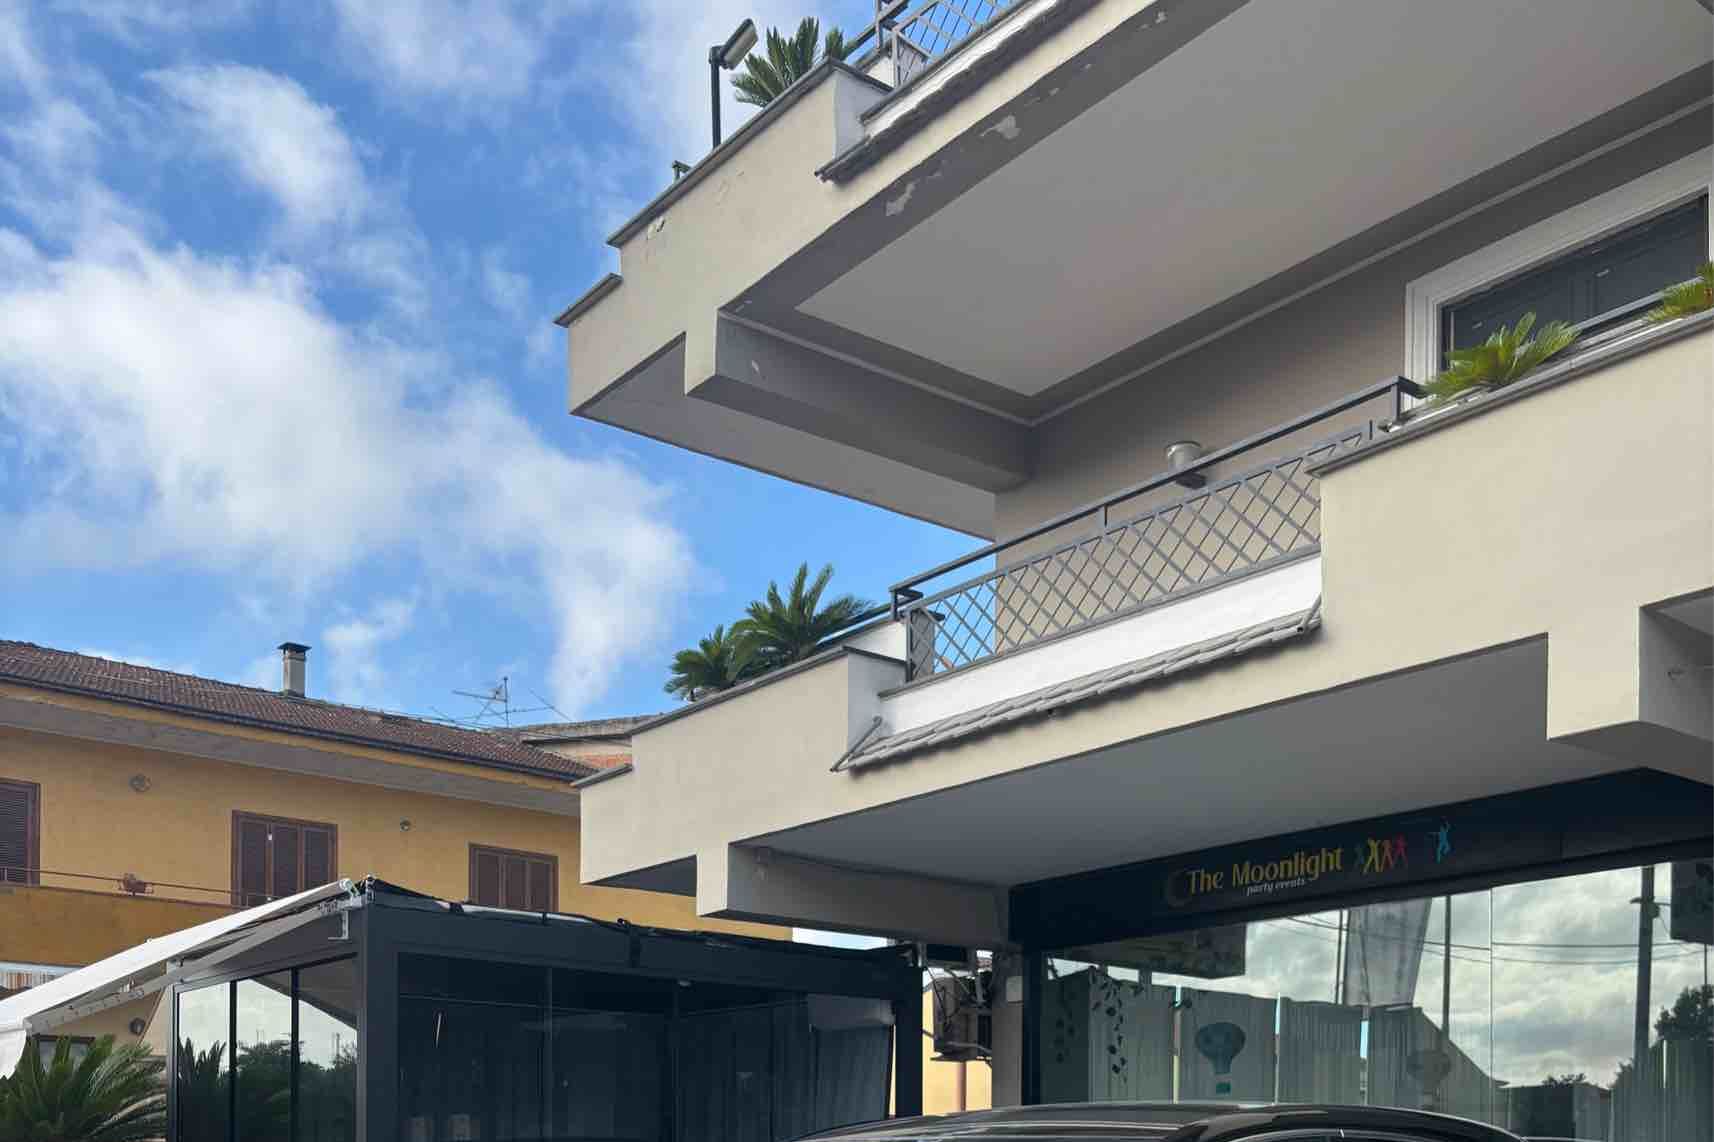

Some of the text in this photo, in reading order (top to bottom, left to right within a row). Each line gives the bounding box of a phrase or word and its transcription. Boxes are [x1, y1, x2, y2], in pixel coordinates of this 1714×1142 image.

[1187, 847, 1344, 894] The Moonlight
[1246, 877, 1306, 897] party events
